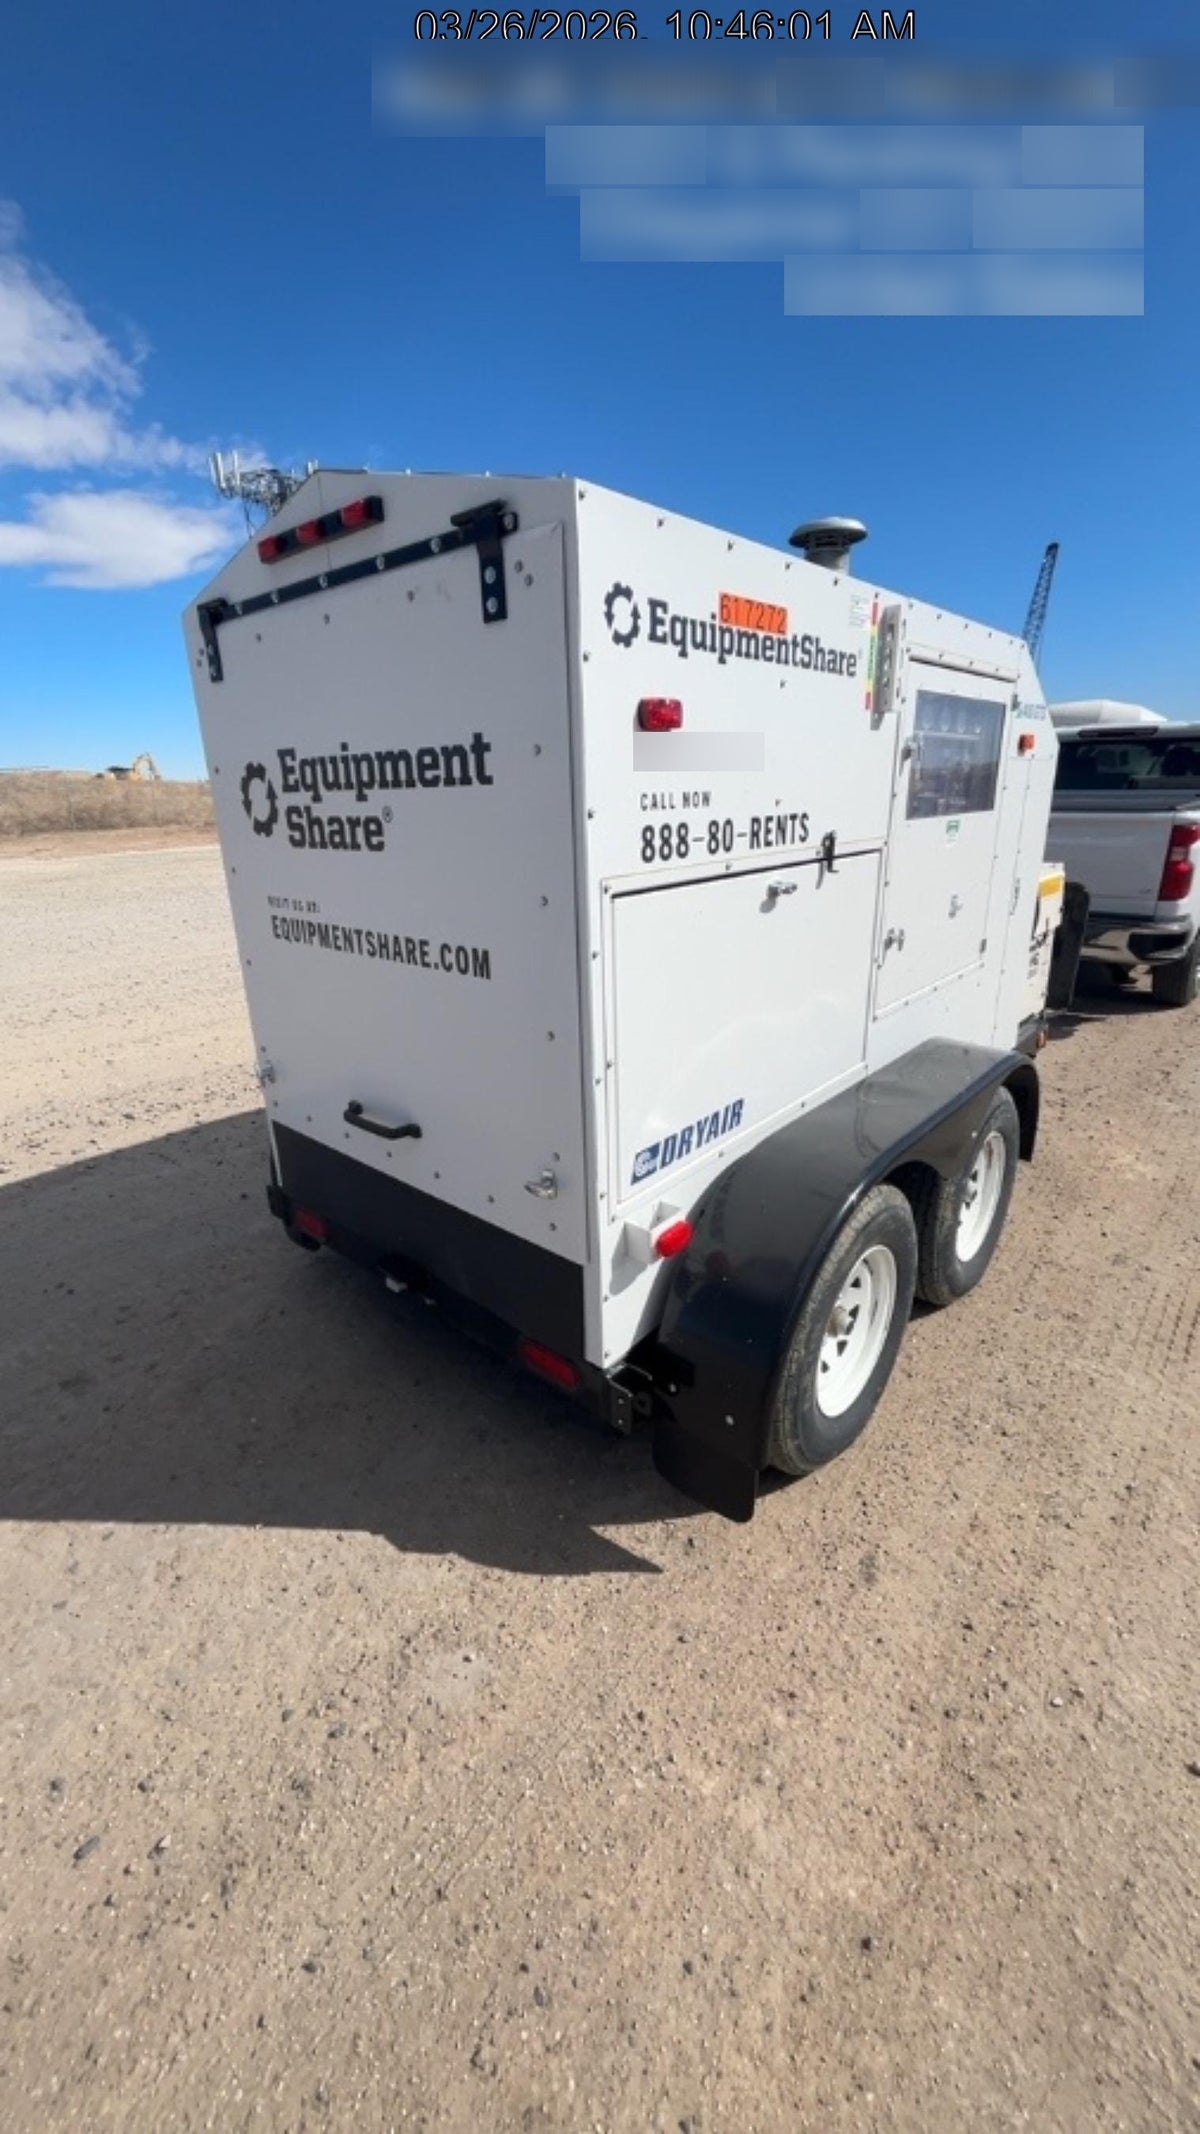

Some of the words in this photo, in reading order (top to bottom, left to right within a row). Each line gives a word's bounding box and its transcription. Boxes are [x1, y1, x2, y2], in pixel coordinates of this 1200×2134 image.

[647, 597, 858, 678] EquipmentShare
[720, 592, 787, 635] 617272
[277, 732, 494, 803] Equipment
[640, 793, 676, 812] CALL
[682, 791, 712, 808] NOW
[640, 812, 810, 864] 888-80-RENTS
[270, 914, 492, 981] EQUIPMENTSHARE.COM
[659, 1097, 745, 1170] DRYAIR
